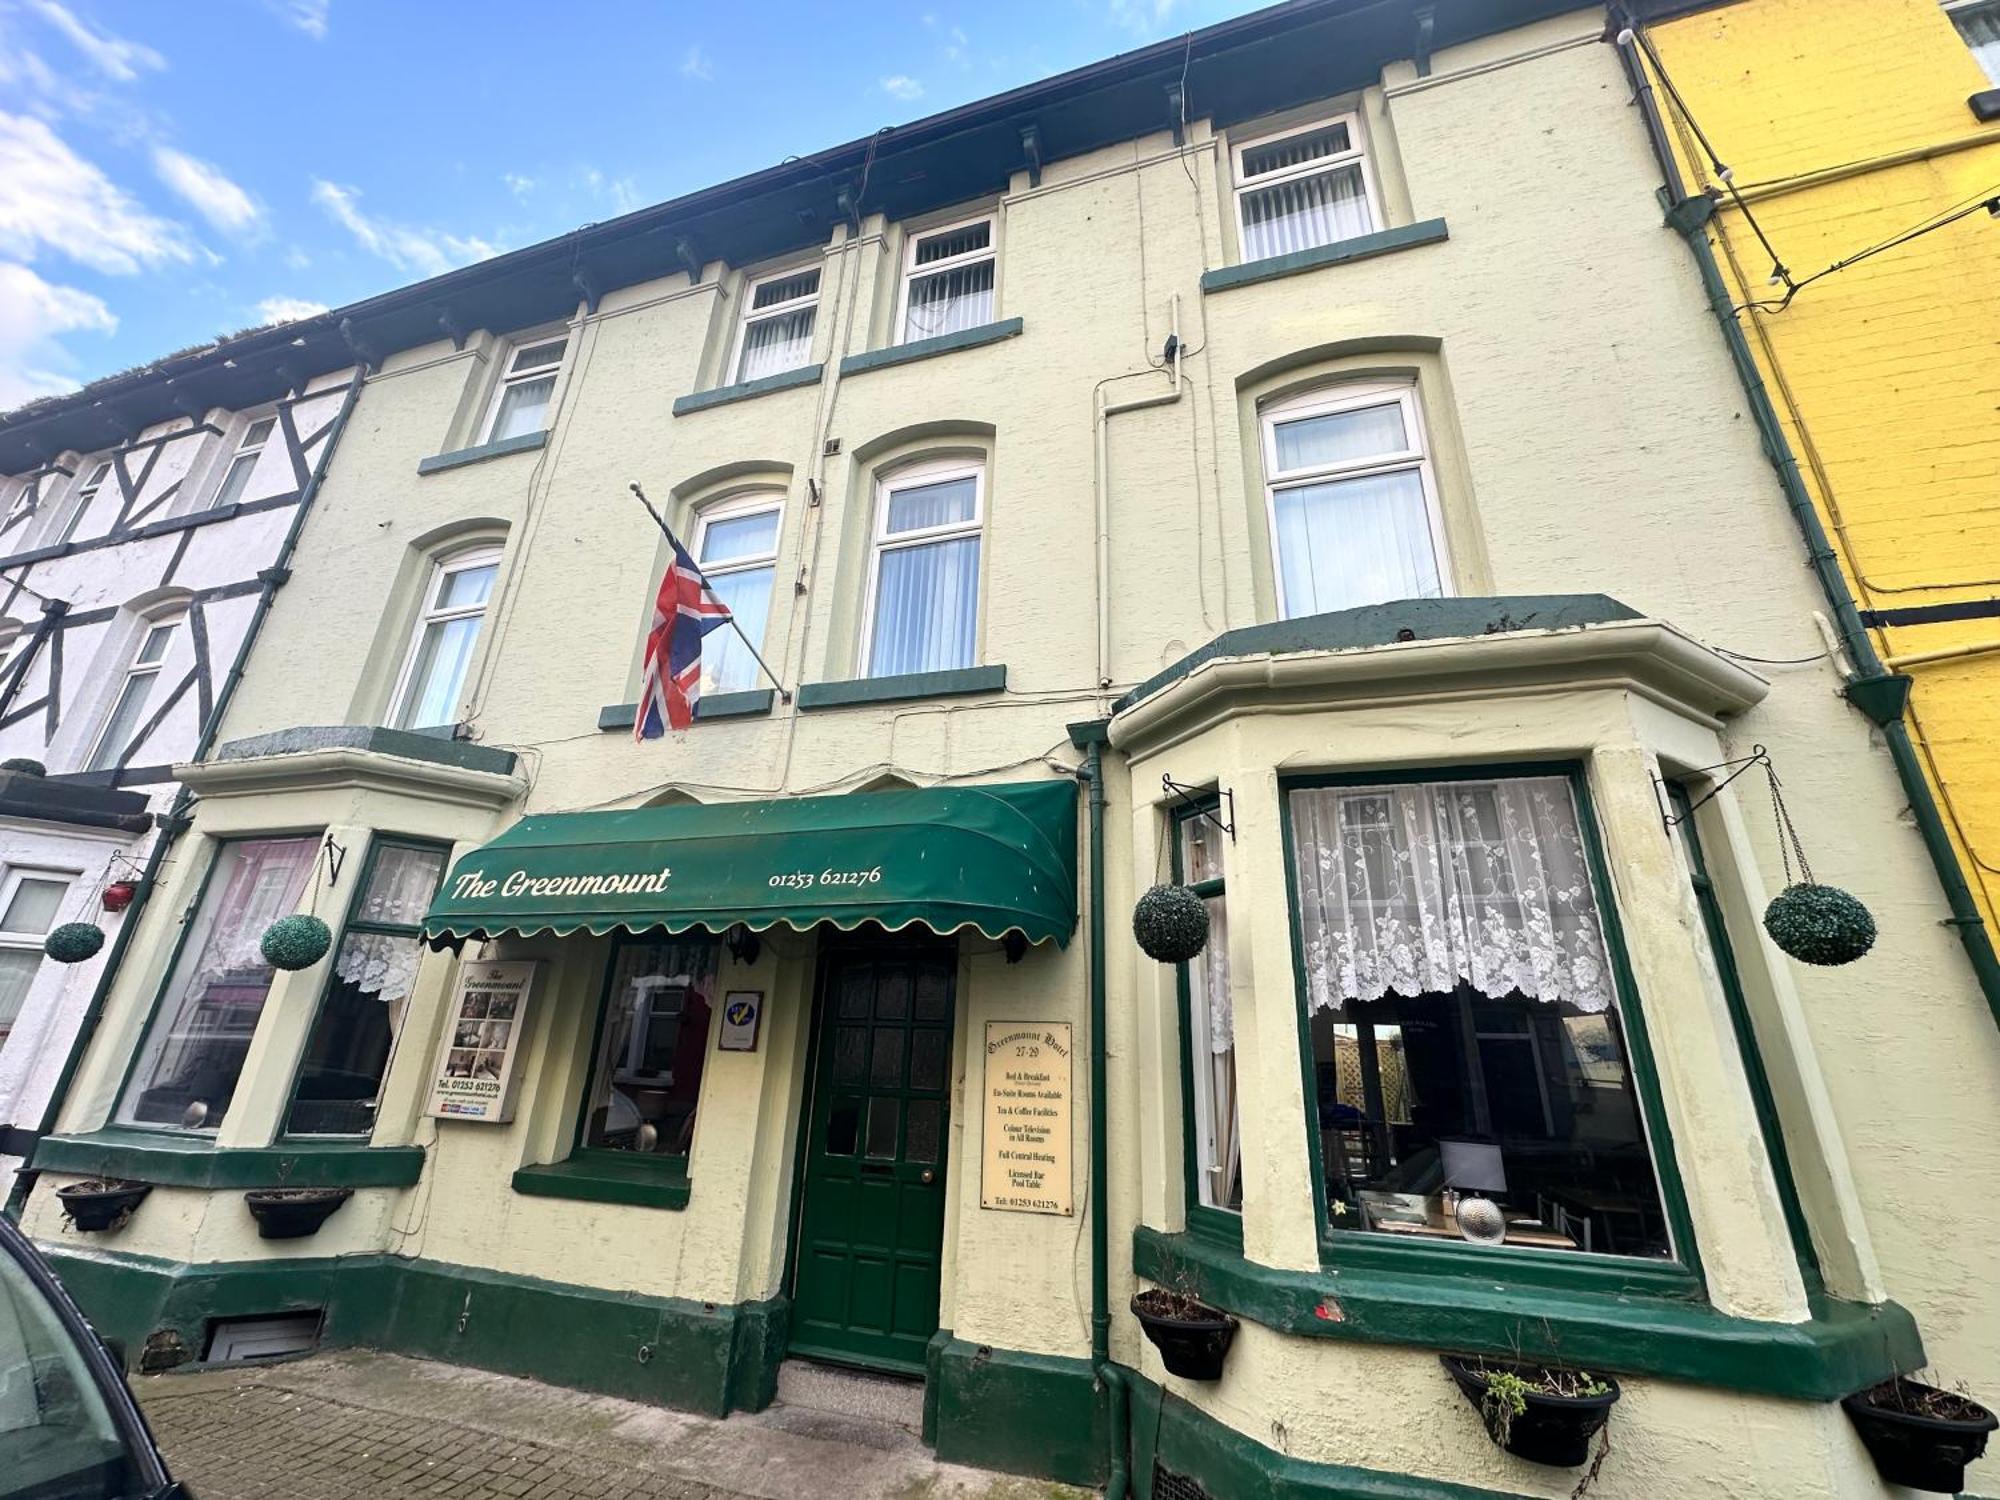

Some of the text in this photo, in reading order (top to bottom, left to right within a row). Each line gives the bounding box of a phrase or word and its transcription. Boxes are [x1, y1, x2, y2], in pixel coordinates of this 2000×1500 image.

[768, 866, 882, 889] 01253 621276
[451, 867, 672, 900] The Greenmount
[987, 1032, 1069, 1058] Greenmount Hotel
[1006, 1072, 1017, 1080] Bed
[1023, 1072, 1050, 1081] Breakfast
[1018, 1089, 1036, 1098] Rooms
[1038, 1090, 1062, 1099] Available
[997, 1106, 1007, 1114] Tea
[1014, 1107, 1032, 1116] Coffee
[1034, 1108, 1058, 1117] Facilities
[1023, 1125, 1051, 1134] Television
[1016, 1133, 1025, 1142] All
[1025, 1134, 1045, 1143] Rooms
[999, 1150, 1056, 1164] Full Central Heating
[1008, 1169, 1033, 1178] Licensed
[1009, 1198, 1031, 1208] 01253
[1032, 1200, 1058, 1209] 621276
